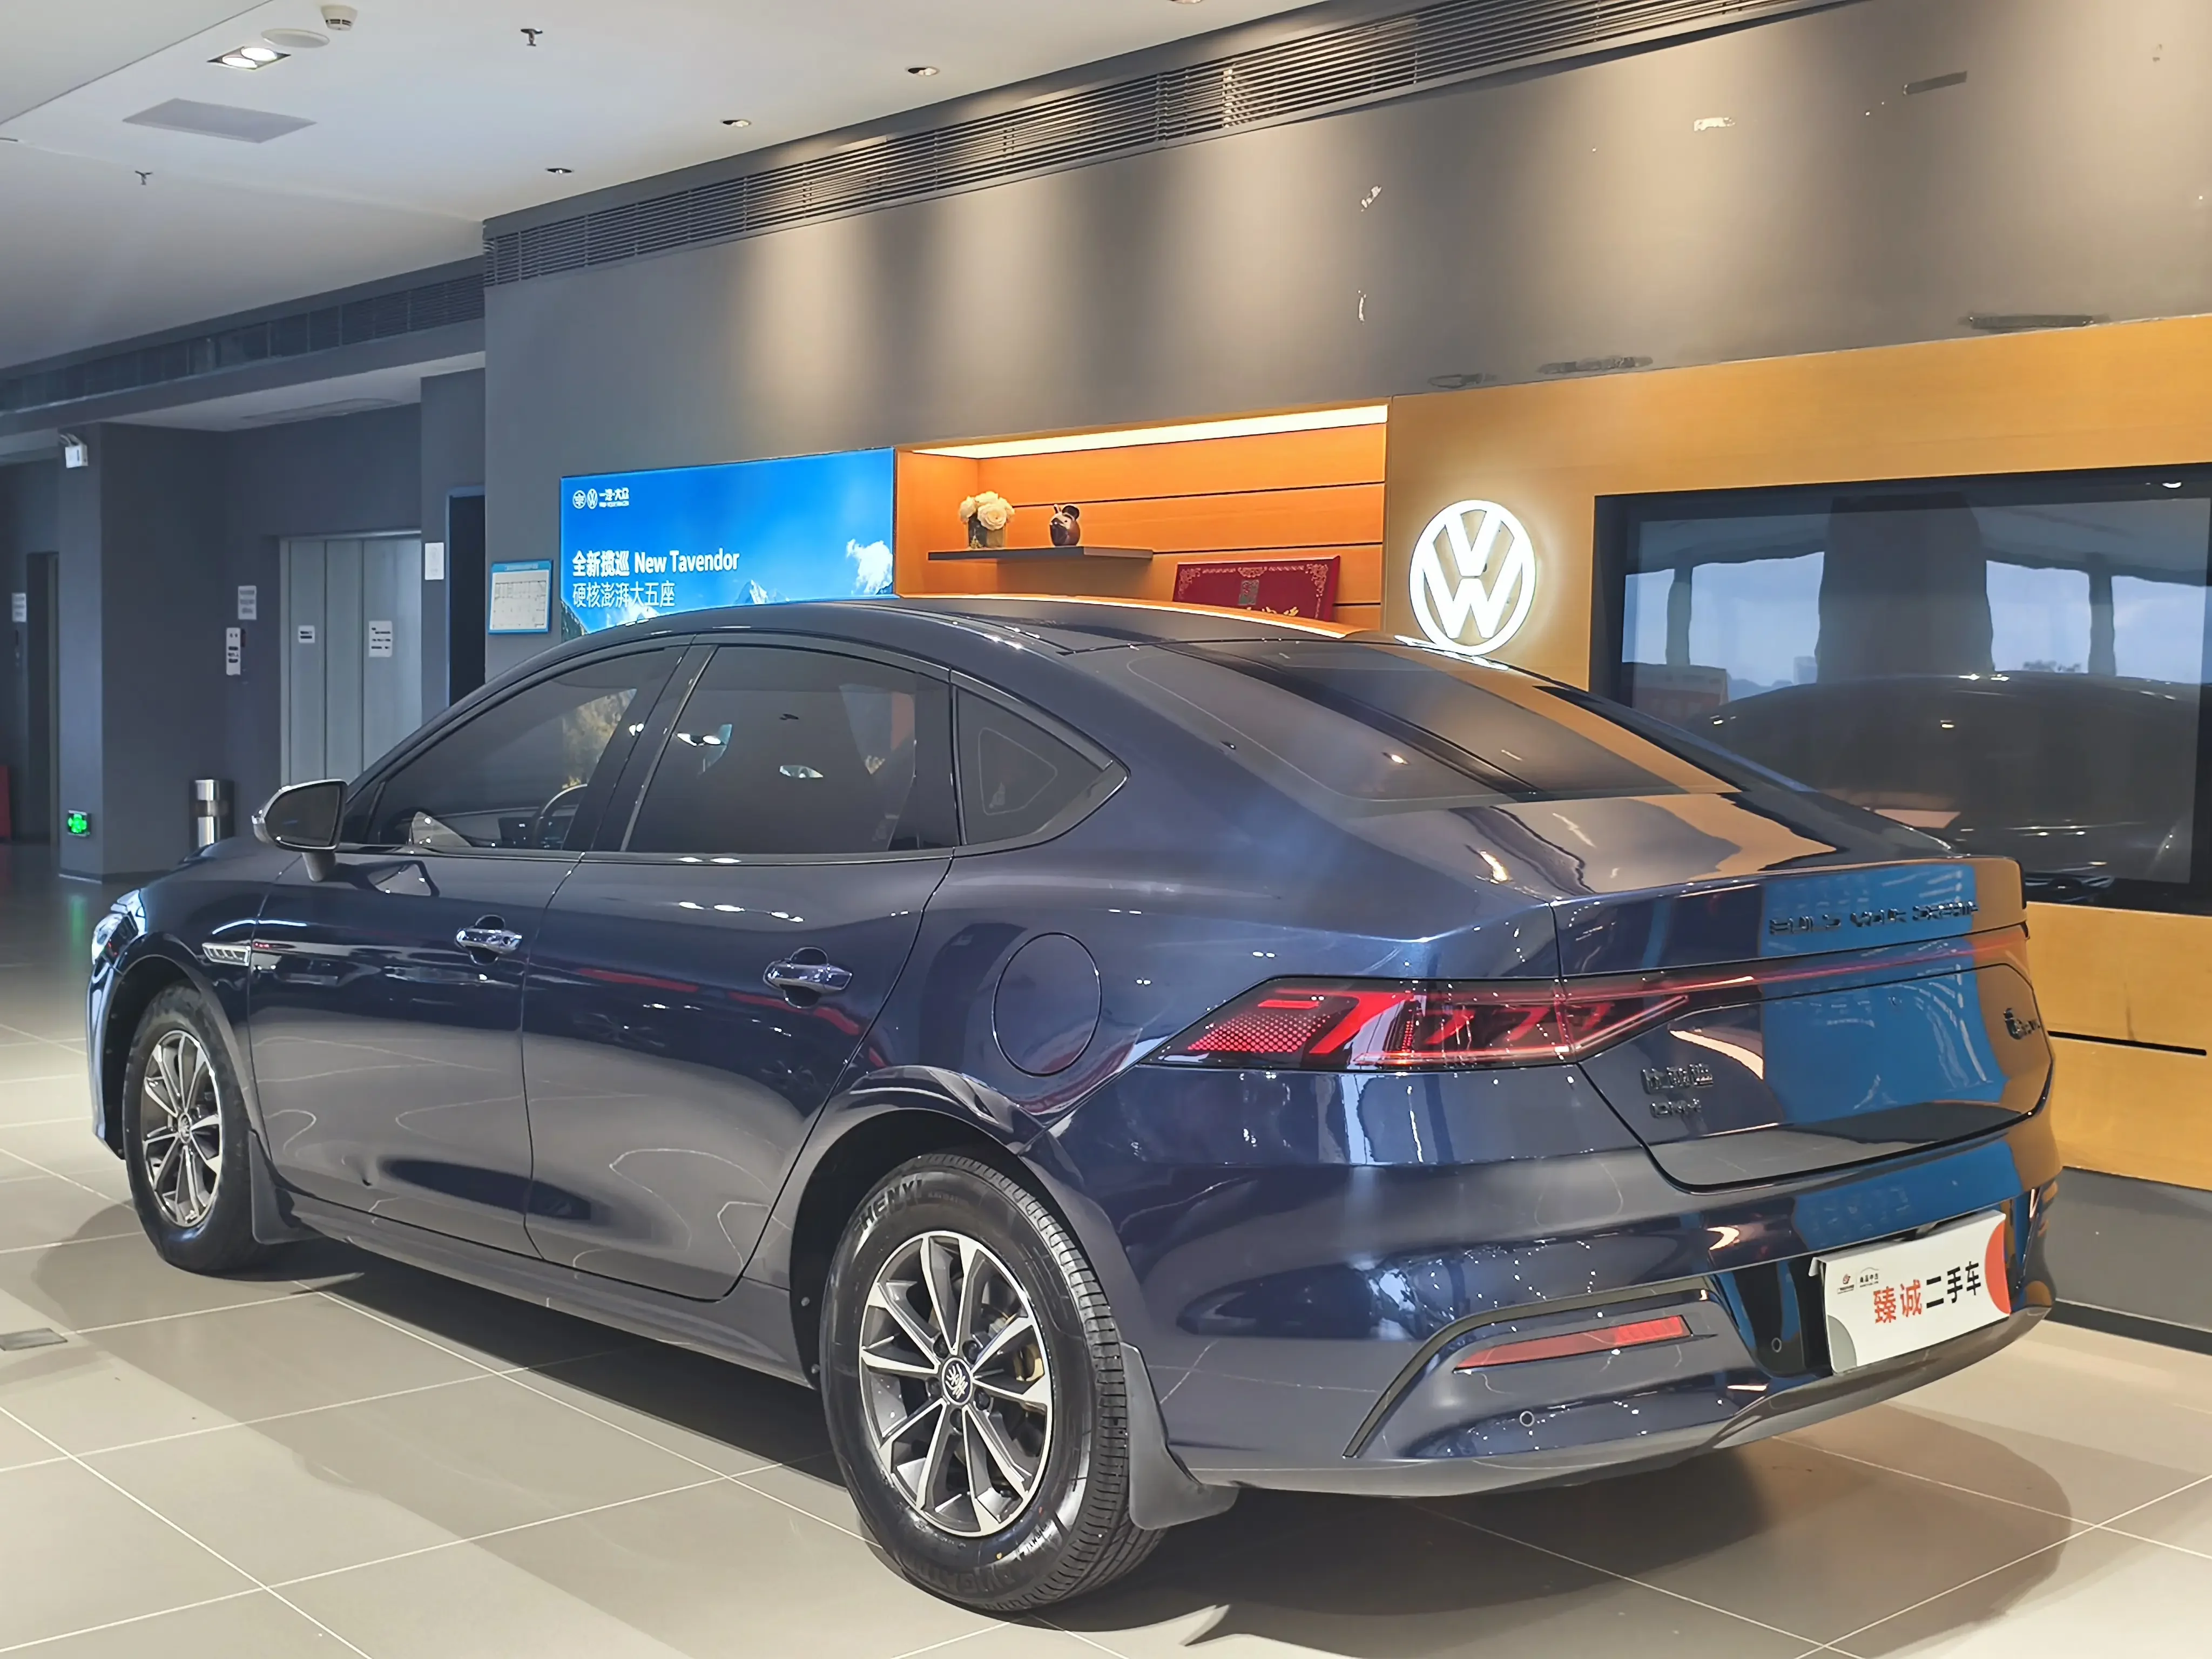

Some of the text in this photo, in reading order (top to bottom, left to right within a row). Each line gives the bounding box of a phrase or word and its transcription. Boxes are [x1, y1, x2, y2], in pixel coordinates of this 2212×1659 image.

[572, 548, 740, 577] 全新揽巡 New Tavendor
[572, 580, 675, 608] 硬核澎湃大五座
[1873, 1261, 1981, 1323] 臻诚二手车
